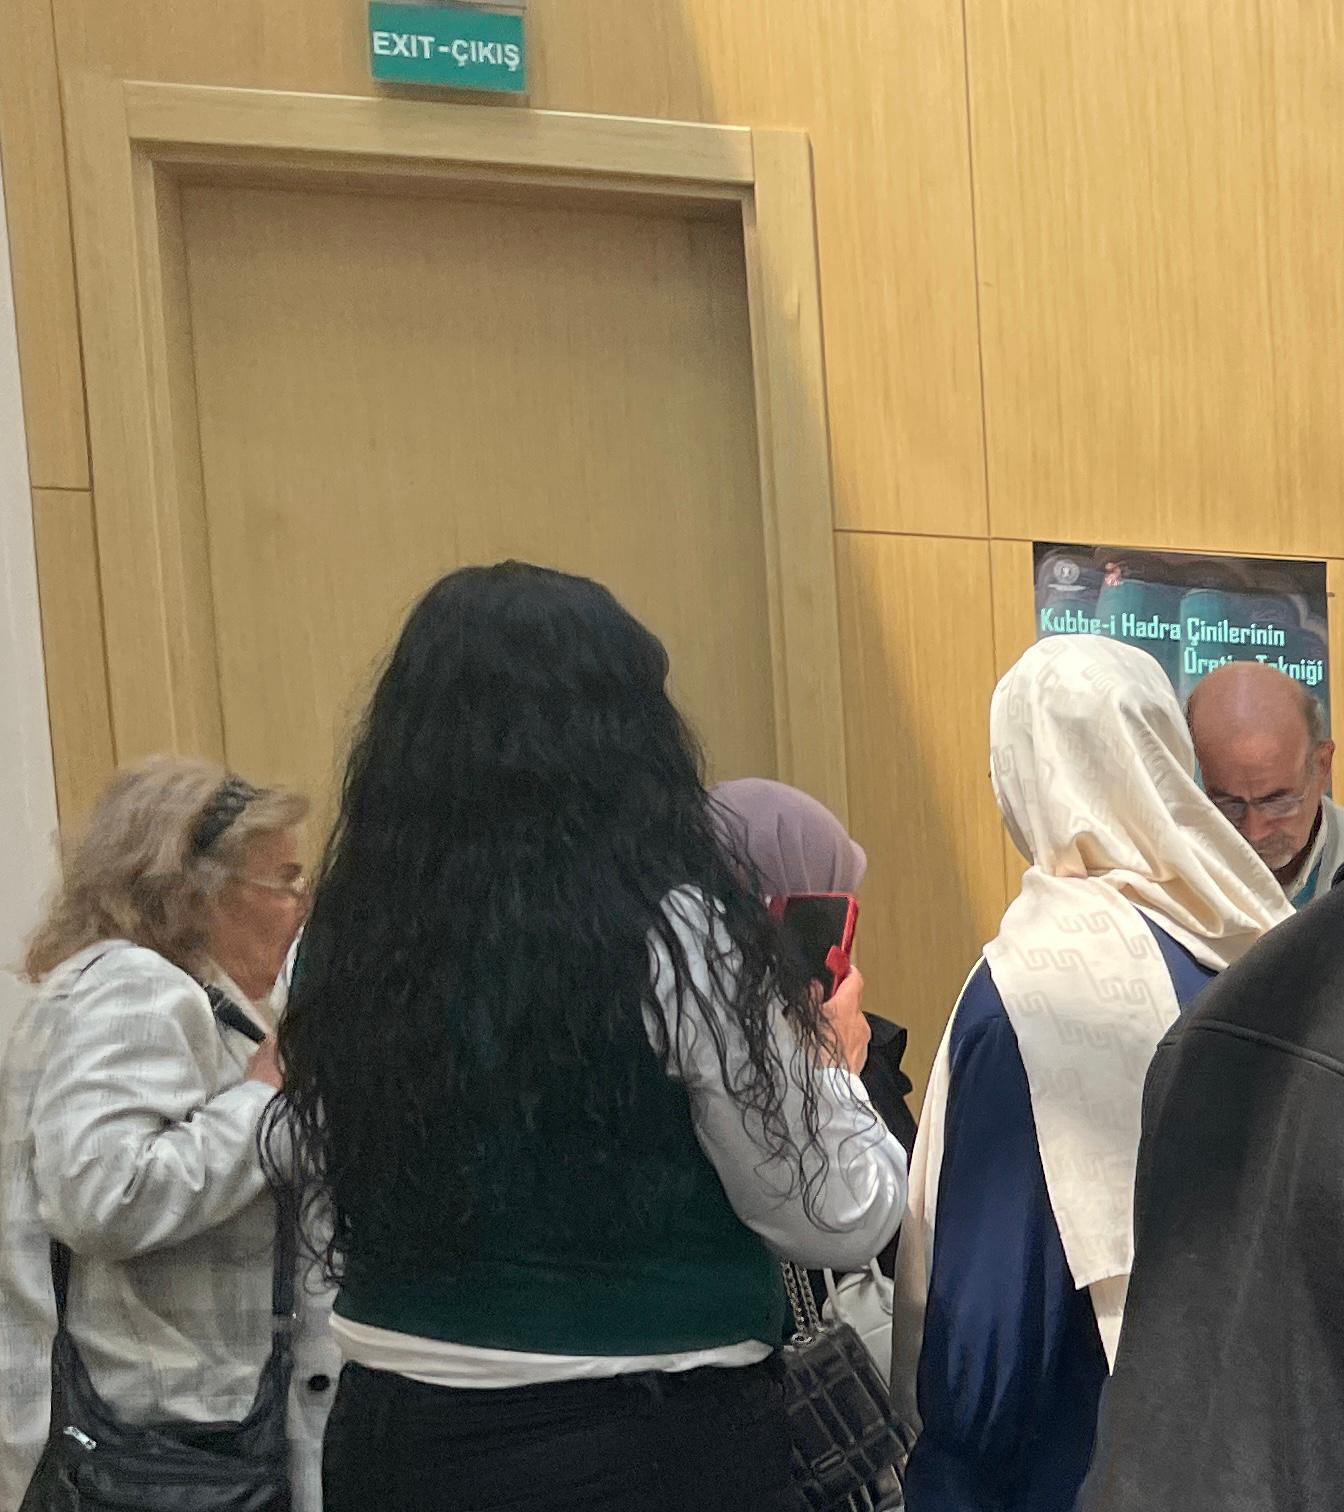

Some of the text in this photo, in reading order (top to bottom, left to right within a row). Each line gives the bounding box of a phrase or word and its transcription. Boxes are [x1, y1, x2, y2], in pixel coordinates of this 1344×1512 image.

[372, 31, 521, 72] EXIT-ÇIKIŞ
[1039, 608, 1286, 647] Kubbe-i Hadra Çinilerinin
